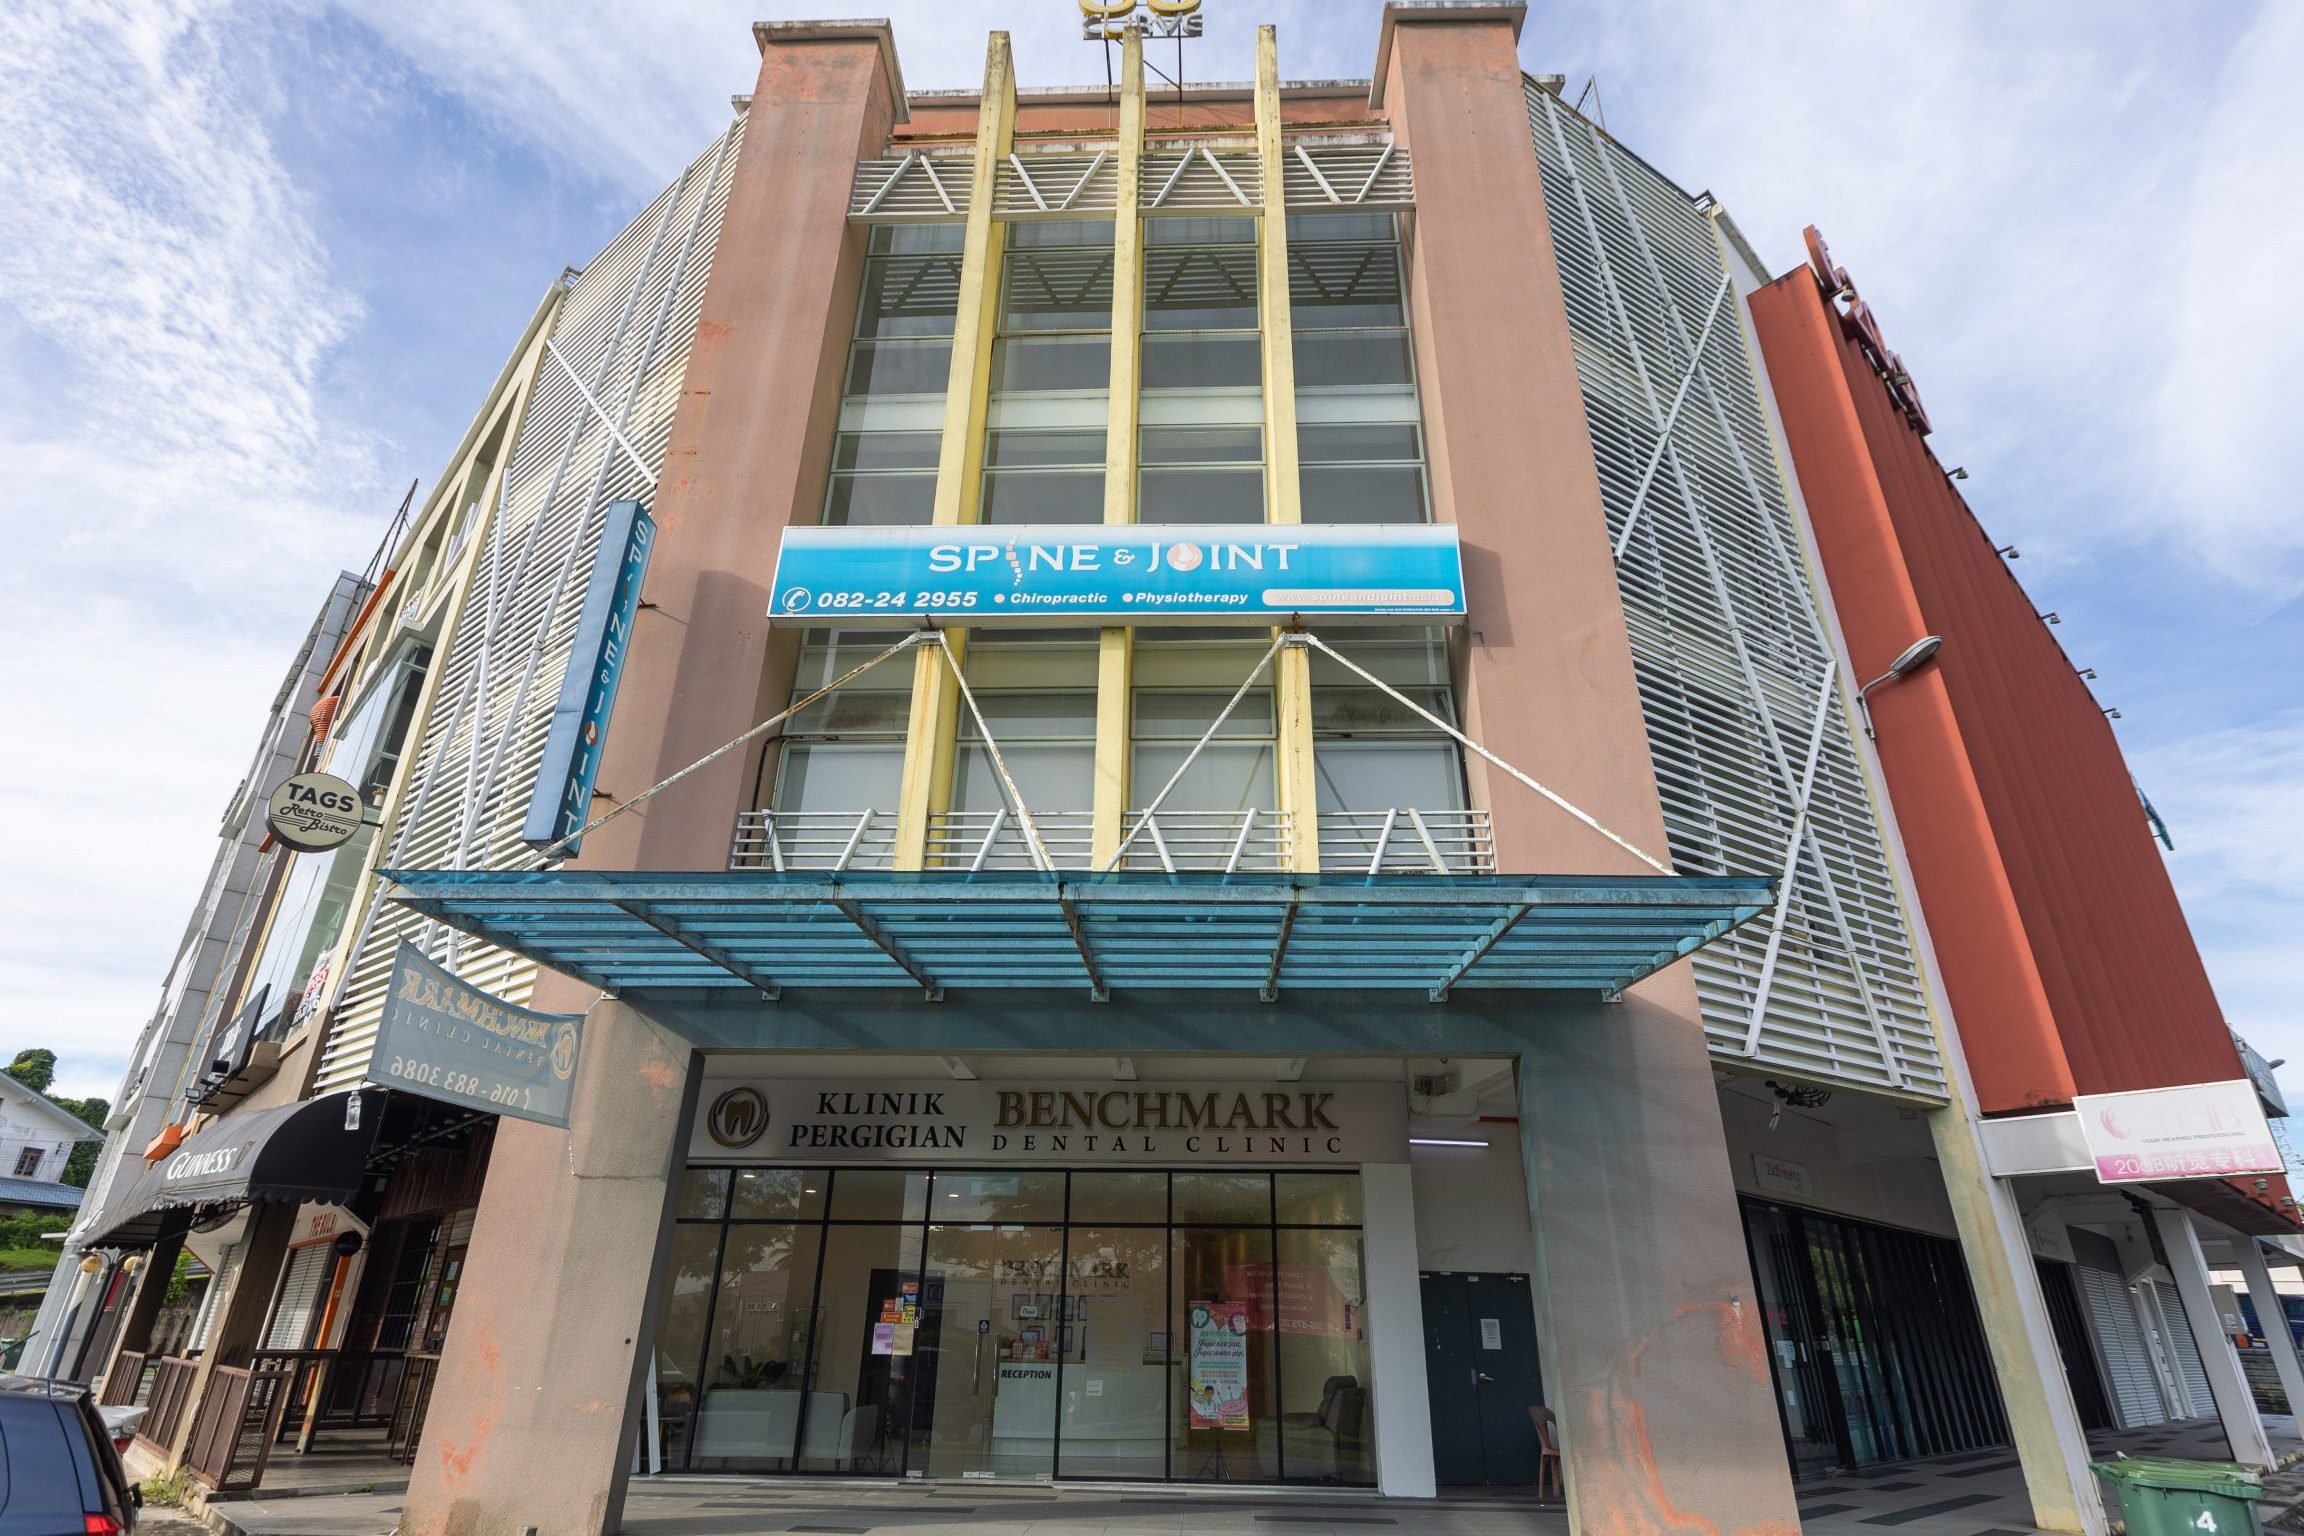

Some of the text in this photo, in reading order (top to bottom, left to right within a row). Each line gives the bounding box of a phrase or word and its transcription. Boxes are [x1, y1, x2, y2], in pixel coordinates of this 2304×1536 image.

[1113, 548, 1135, 565] &
[1147, 541, 1298, 572] JOINT
[817, 591, 978, 608] 082-24 2955
[1010, 592, 1108, 605] Chiropractic
[1136, 592, 1249, 606] Physiotherapy
[601, 670, 610, 684] &
[288, 783, 354, 812] TAGS
[280, 803, 323, 819] Retro
[299, 819, 347, 835] Bistro
[816, 1092, 945, 1115] KLINIK
[993, 1090, 1340, 1131] BENCHMARK
[789, 1124, 968, 1148] PERGIGIAN
[992, 1134, 1342, 1154] DENTAL CLINIC
[2194, 1131, 2247, 1140] PROFESSIONAL
[167, 1147, 238, 1180] GUINNESS
[1001, 1369, 1052, 1380] RECEPTION
[2196, 1510, 2218, 1533] 4
